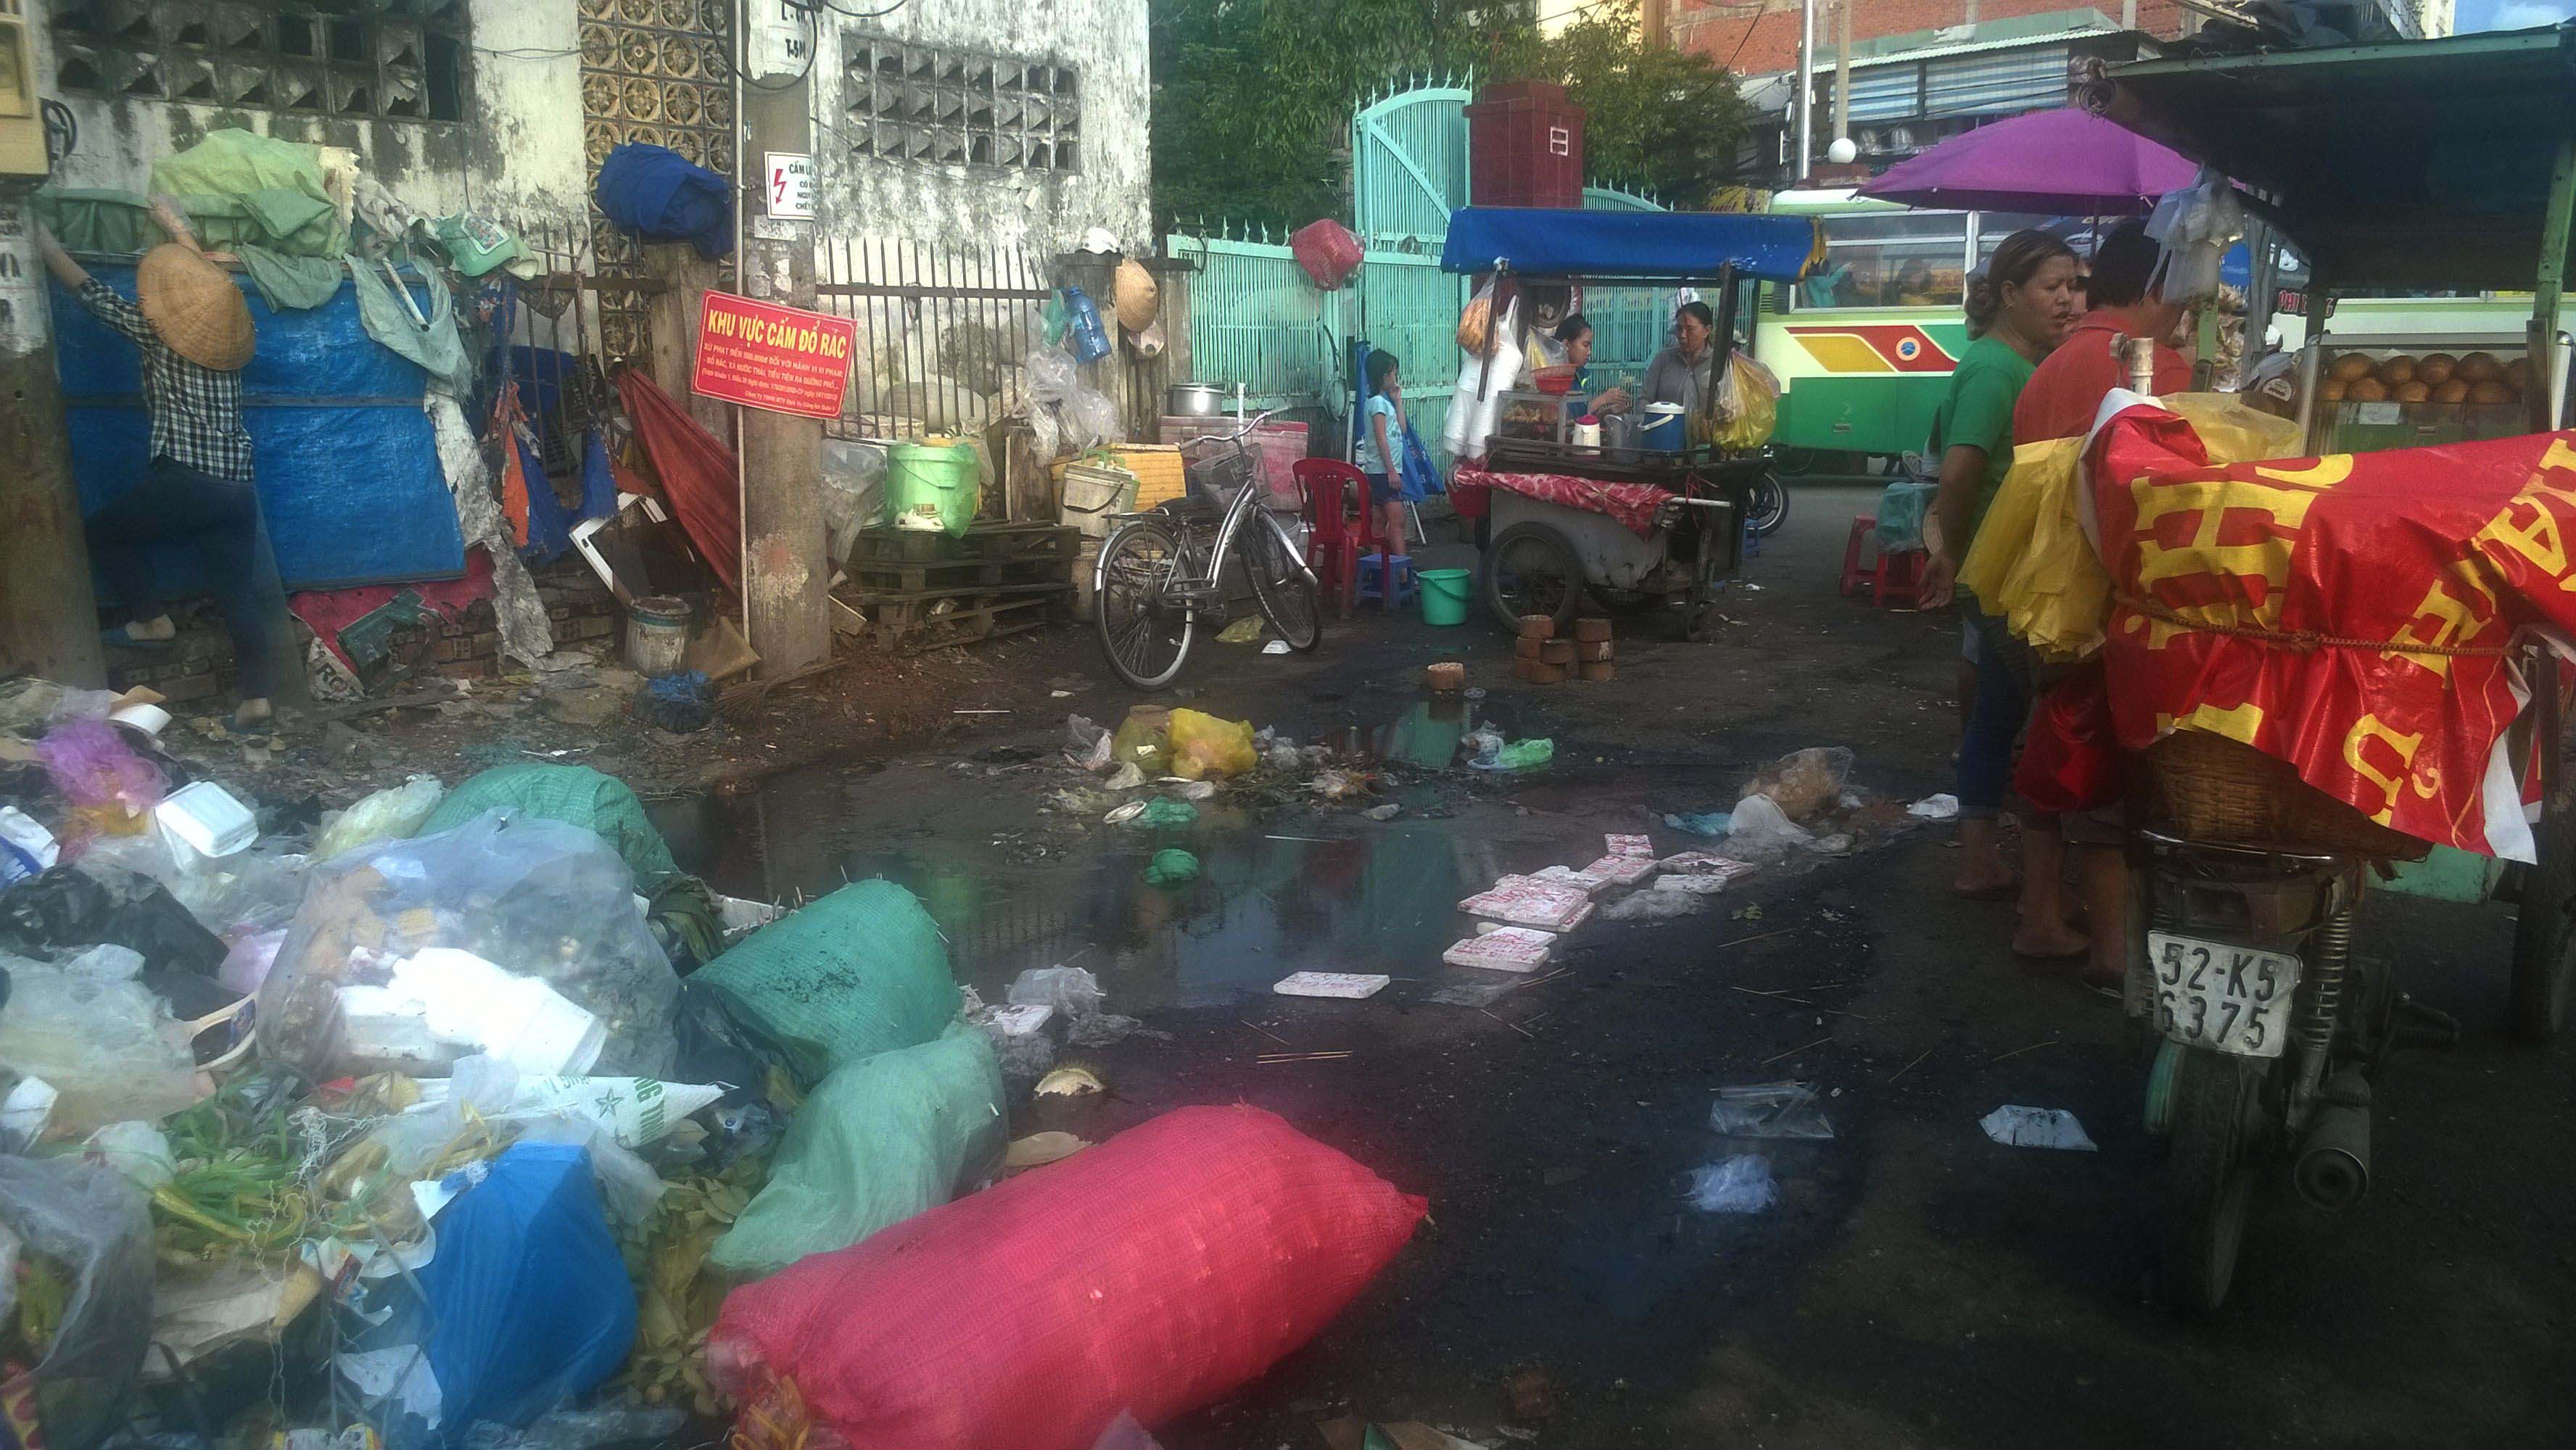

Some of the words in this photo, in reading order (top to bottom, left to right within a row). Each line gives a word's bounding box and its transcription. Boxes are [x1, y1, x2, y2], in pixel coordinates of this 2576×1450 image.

[789, 160, 805, 175] CẤM
[708, 310, 736, 337] KHU
[739, 315, 765, 348] VỰC
[767, 317, 797, 350] CẤM
[798, 320, 820, 354] ĐỔ
[820, 328, 846, 359] RÁC
[2161, 942, 2279, 1002] 52-K5
[2160, 990, 2269, 1049] 6375
